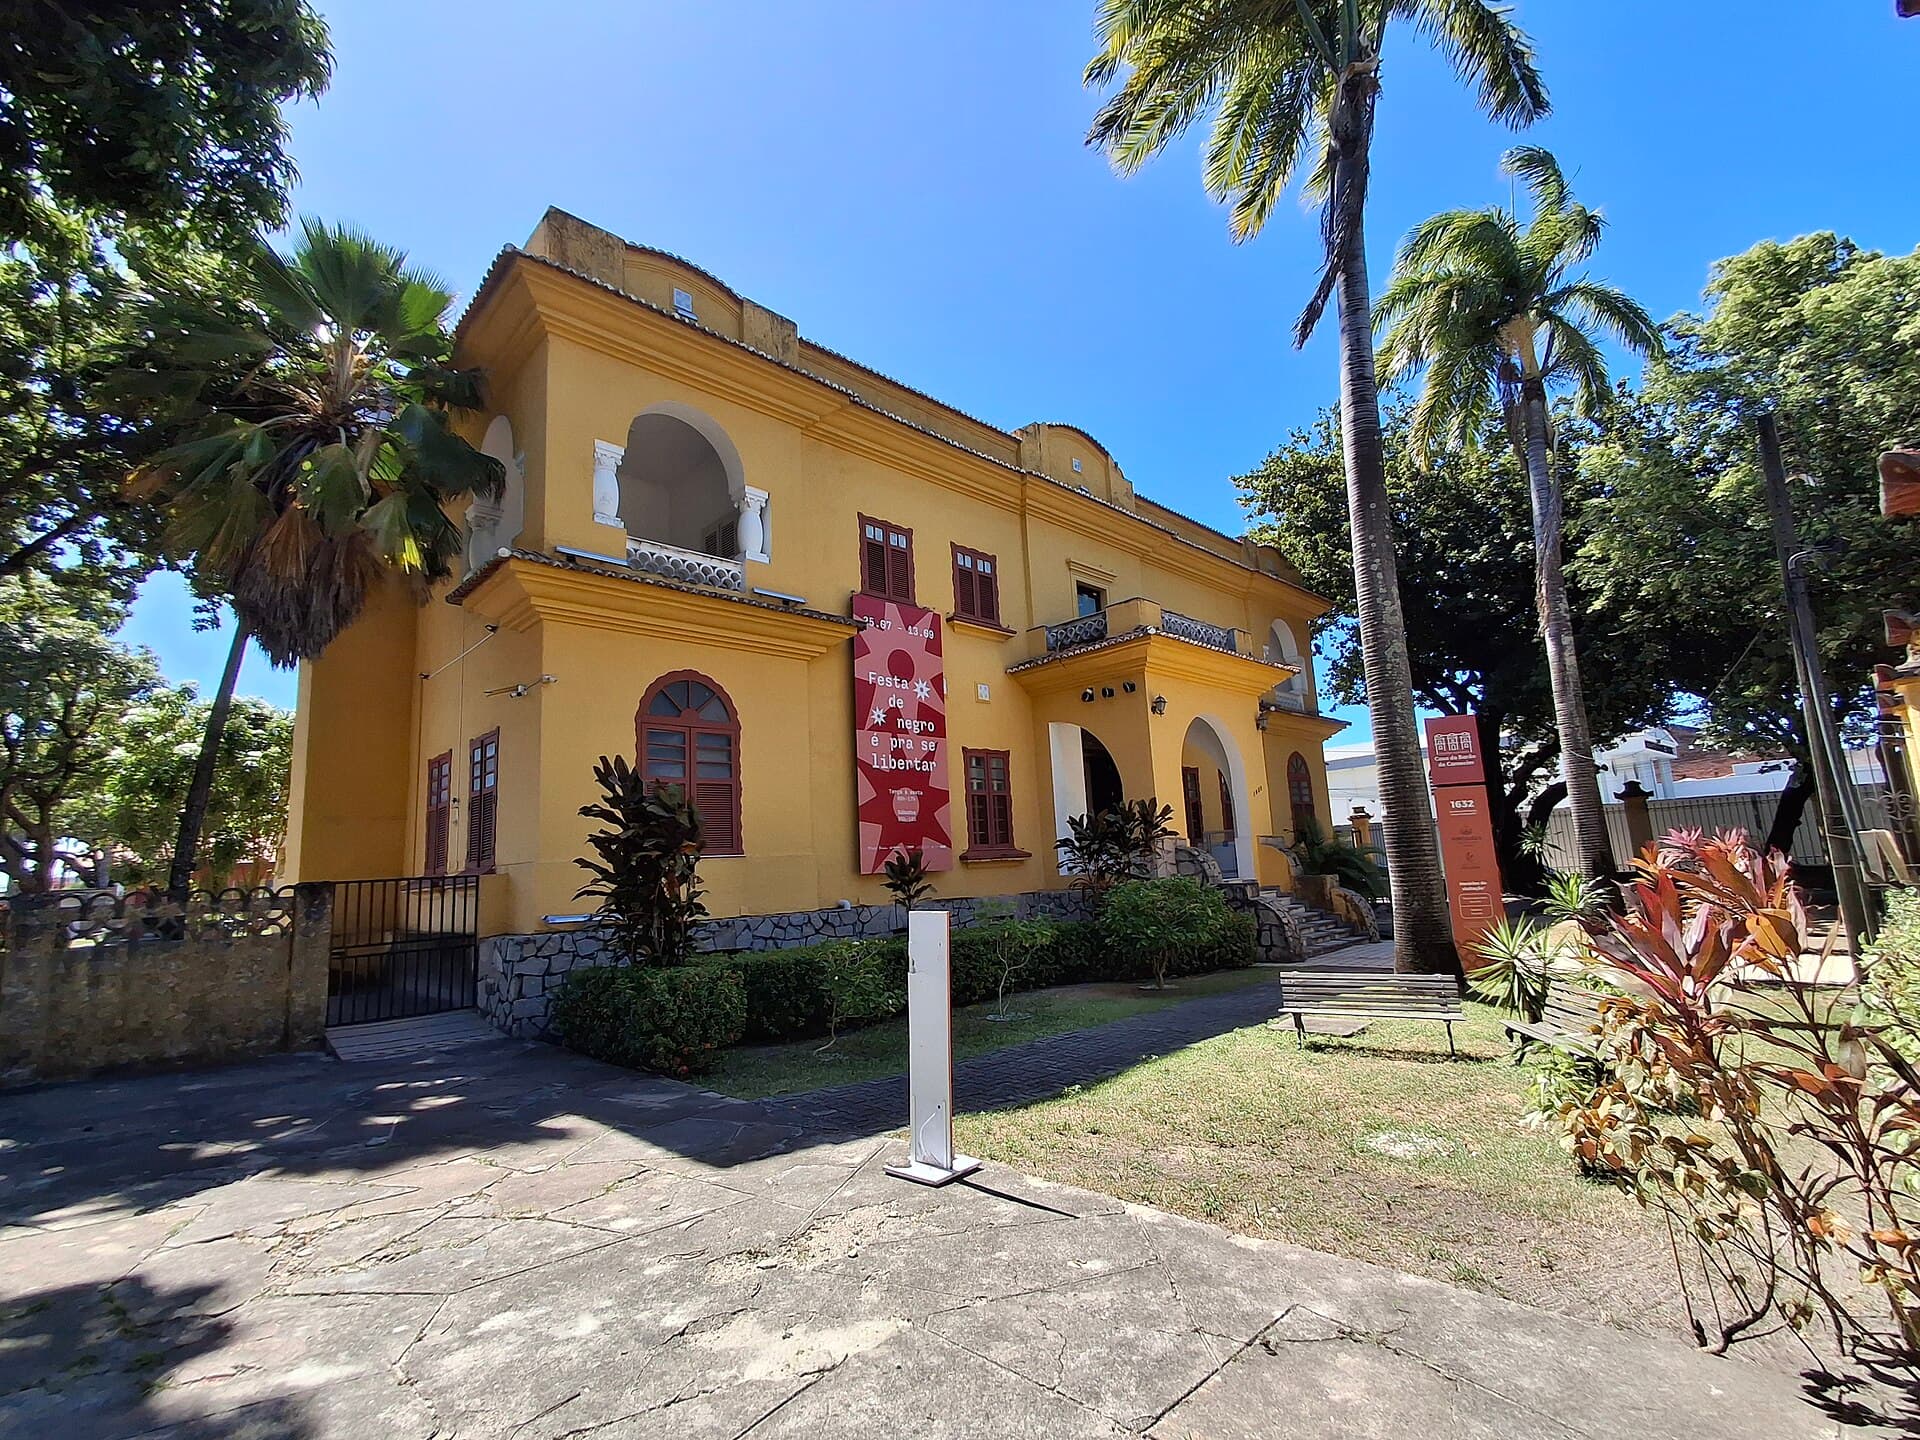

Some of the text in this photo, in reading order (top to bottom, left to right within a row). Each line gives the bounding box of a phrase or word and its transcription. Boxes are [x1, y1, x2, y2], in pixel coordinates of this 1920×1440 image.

[907, 625, 934, 640] 13.09
[868, 671, 910, 690] Festa
[888, 694, 904, 708] de
[896, 718, 935, 733] negro
[871, 732, 936, 752] é pra se
[871, 753, 937, 772] libertar
[1449, 799, 1475, 808] 1632
